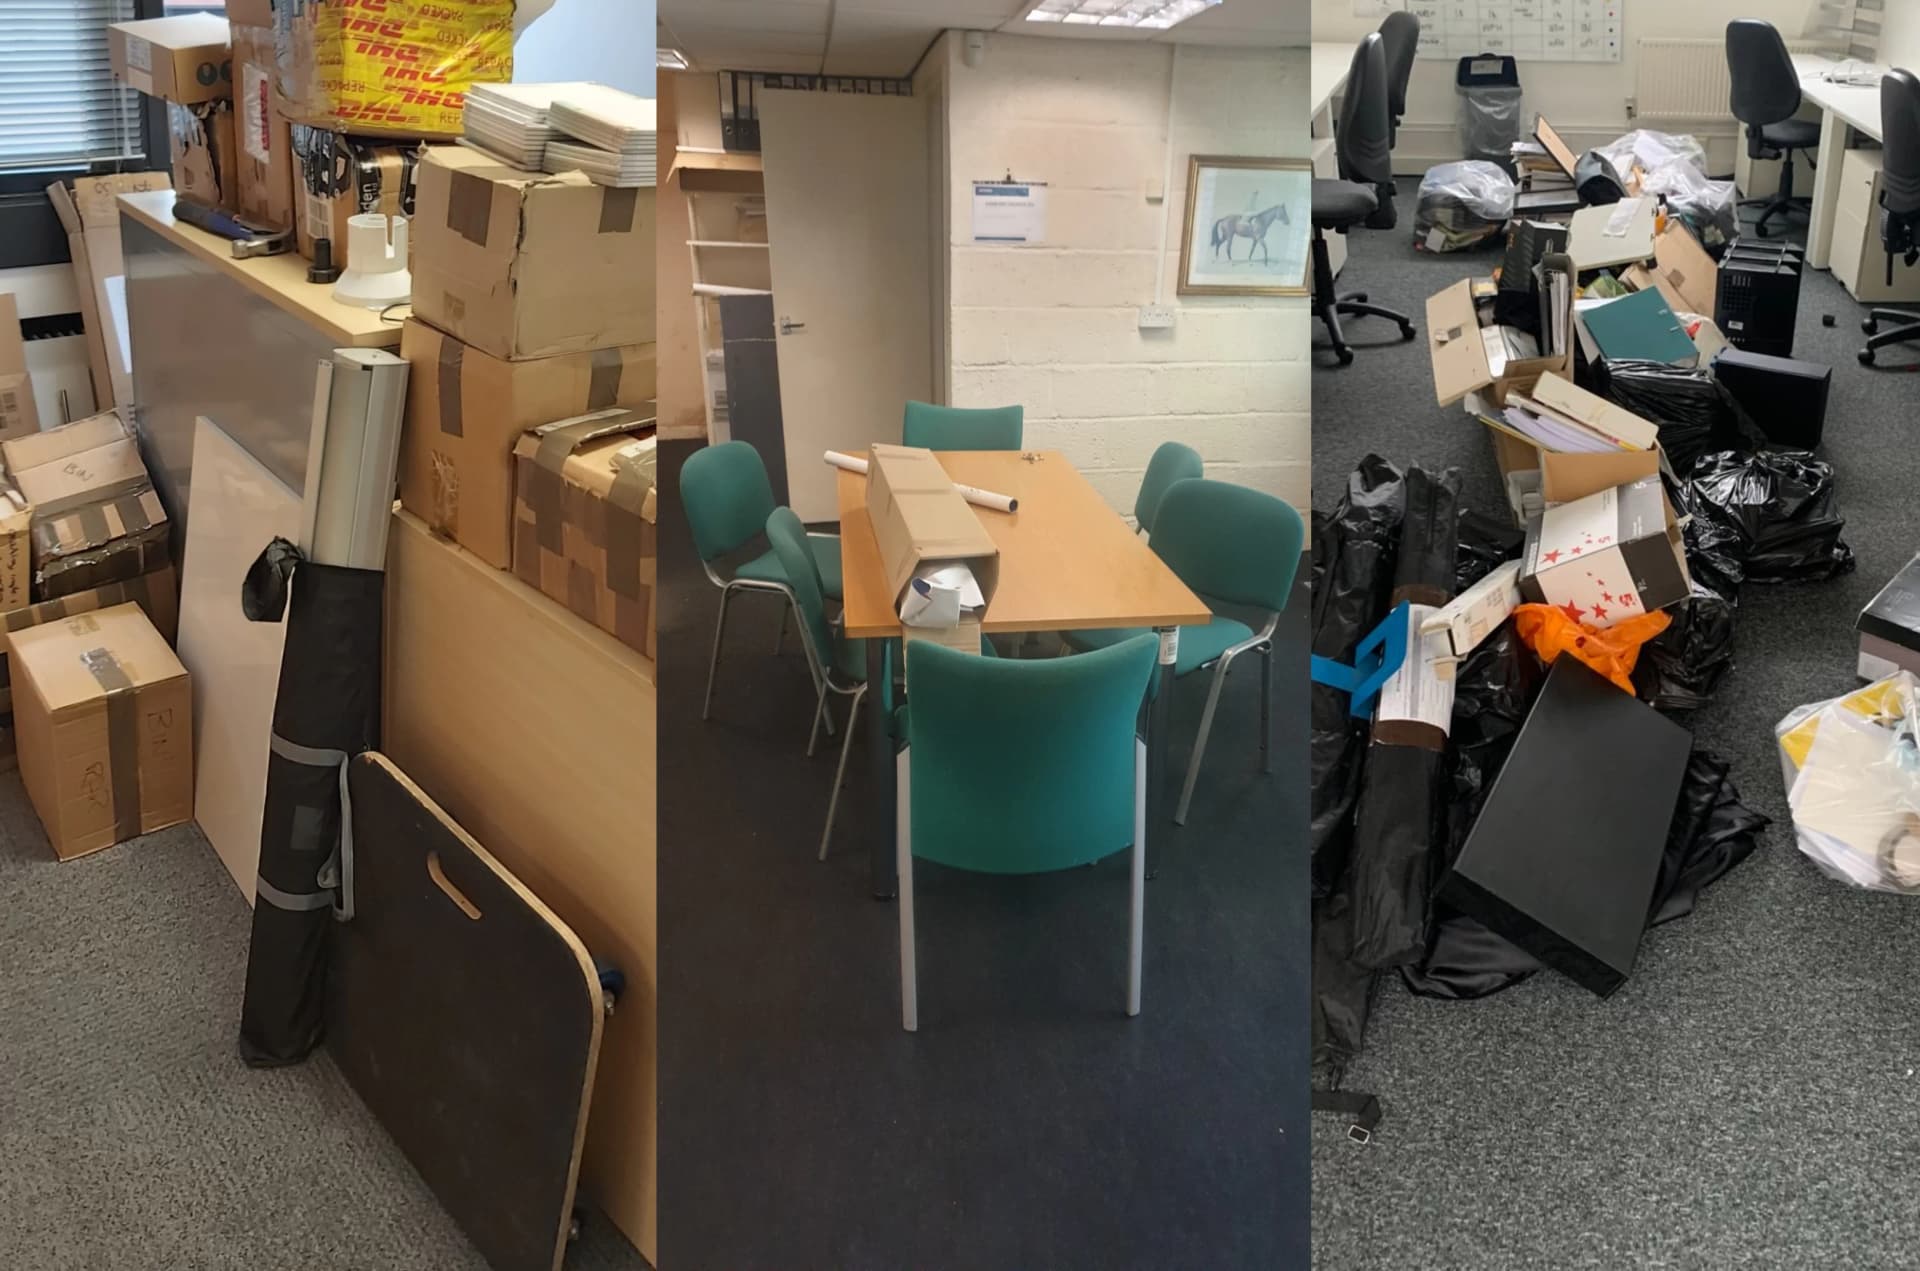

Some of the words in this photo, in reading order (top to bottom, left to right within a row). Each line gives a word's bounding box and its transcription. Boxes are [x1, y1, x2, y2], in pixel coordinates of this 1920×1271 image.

[355, 40, 420, 62] DHL
[396, 87, 464, 110] DHL
[334, 100, 408, 123] DHL
